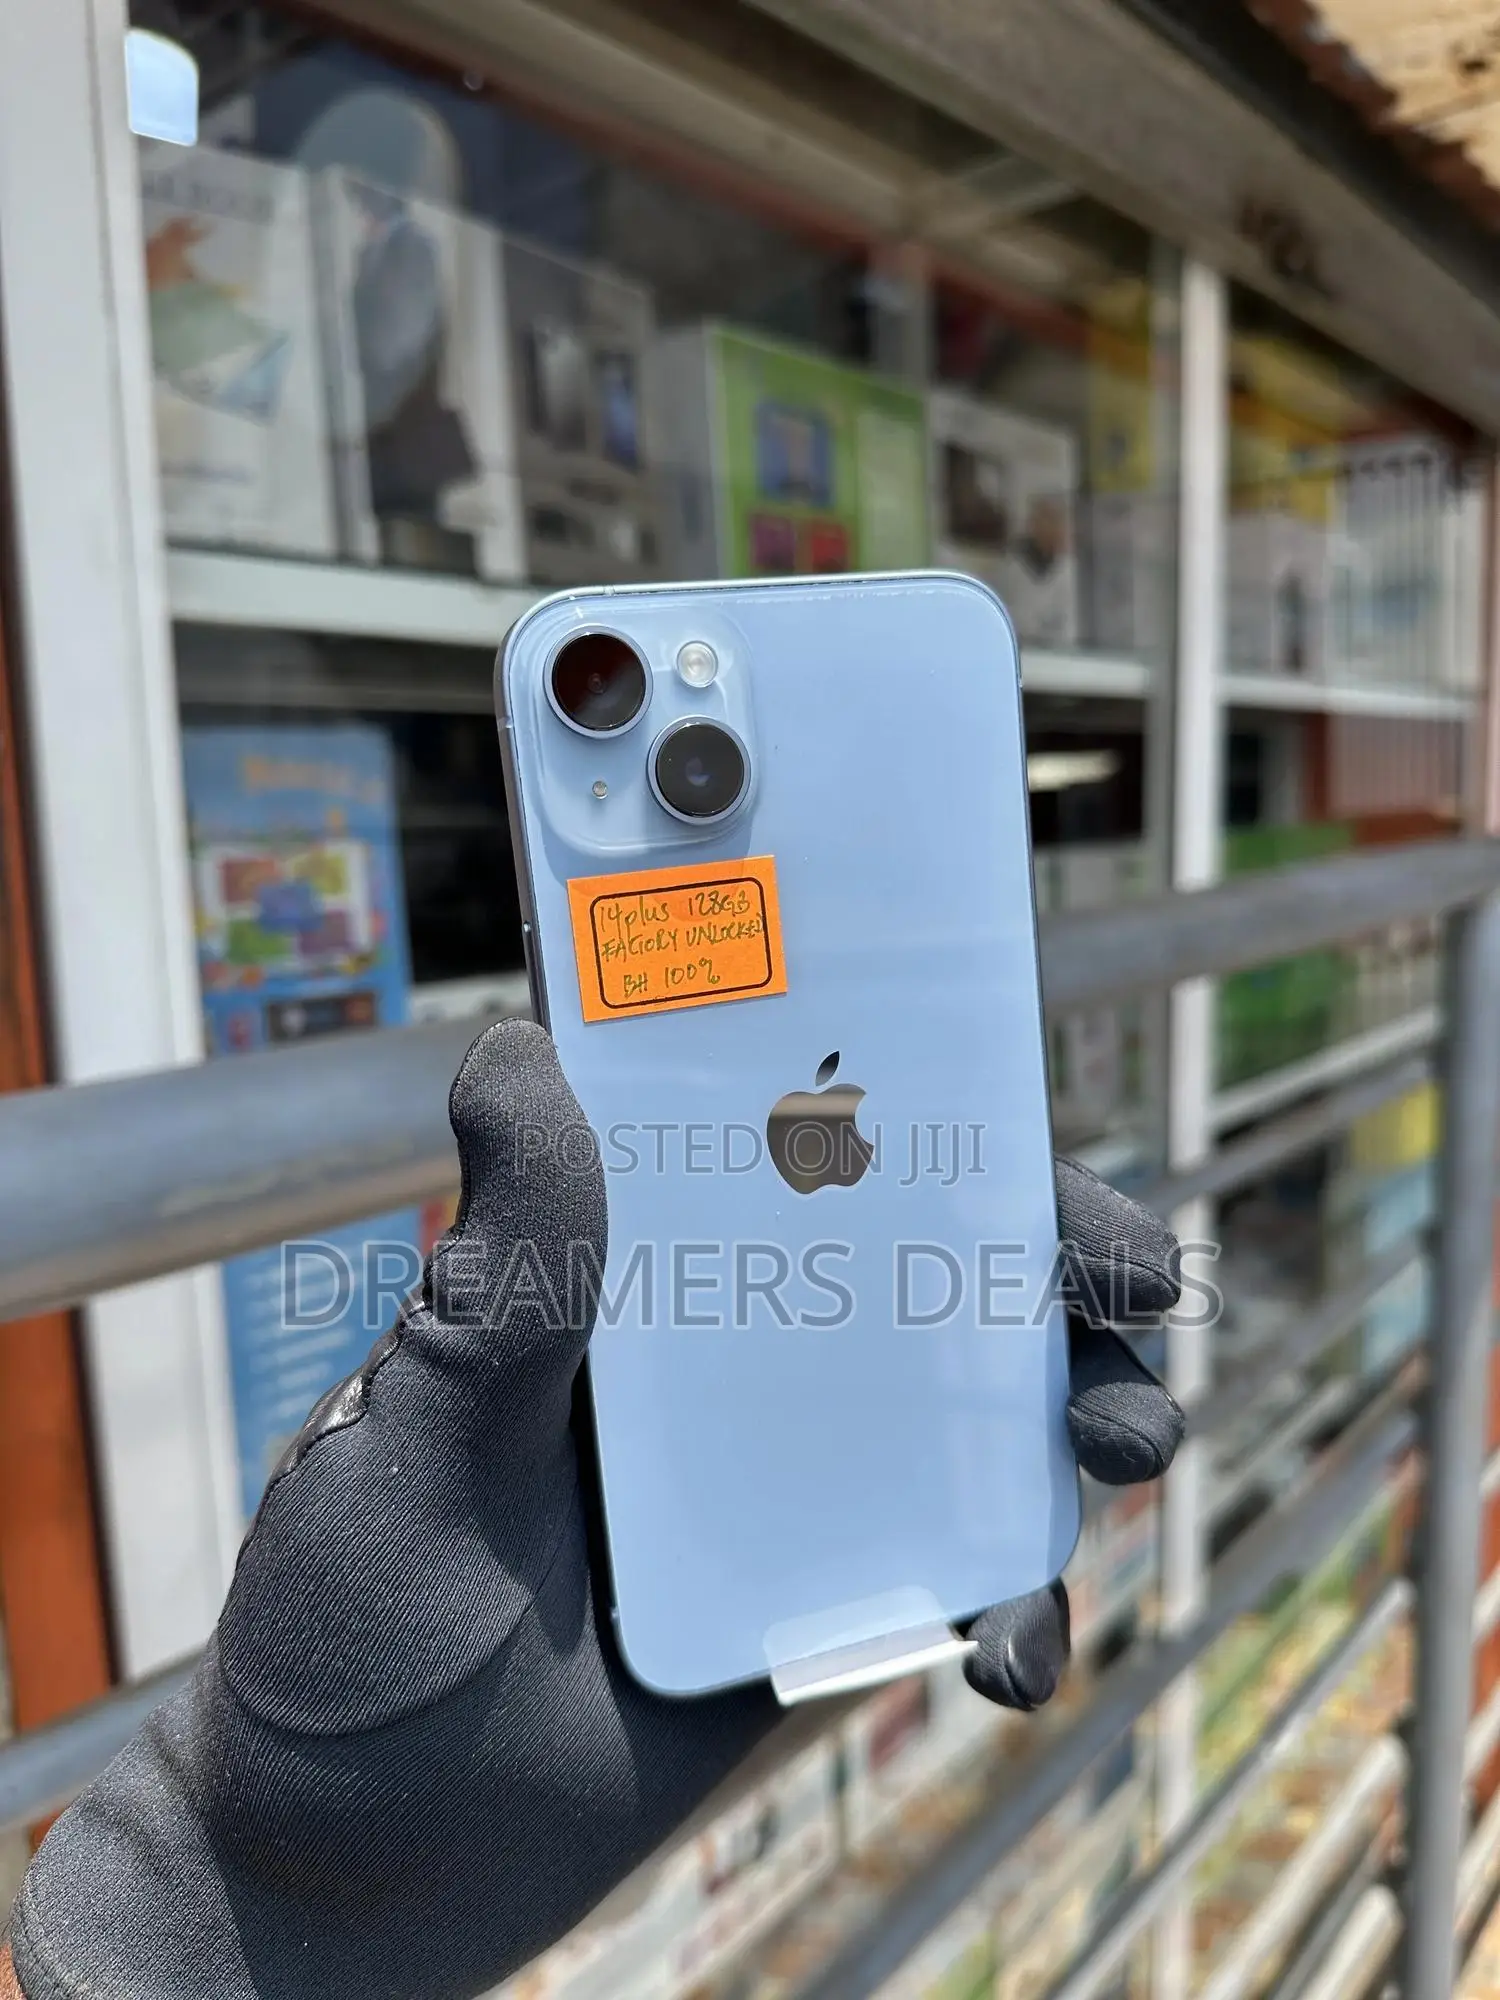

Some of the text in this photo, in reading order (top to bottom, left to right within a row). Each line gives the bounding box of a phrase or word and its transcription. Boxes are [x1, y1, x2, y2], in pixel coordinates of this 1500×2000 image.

[688, 890, 751, 917] 128GB
[601, 913, 764, 962] FACTORY UNLOCKED
[623, 957, 721, 997] BH 100%
